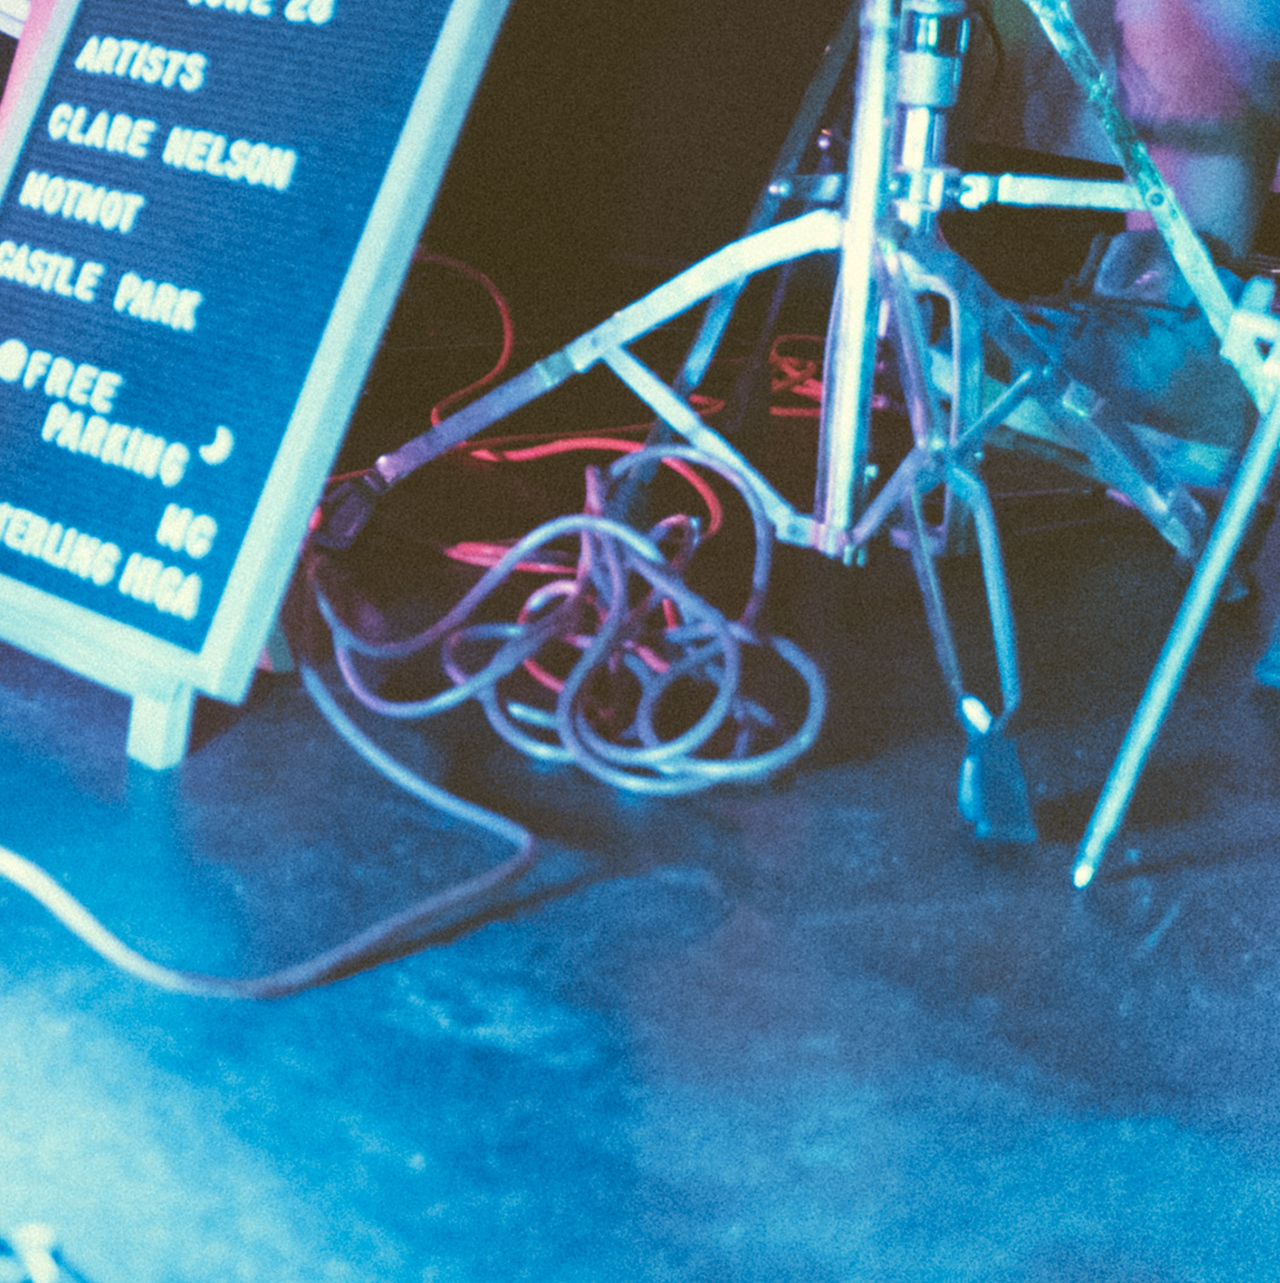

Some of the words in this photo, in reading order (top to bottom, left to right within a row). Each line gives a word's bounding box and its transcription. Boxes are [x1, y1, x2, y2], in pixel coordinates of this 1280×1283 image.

[73, 35, 208, 92] ARTISTS
[47, 102, 158, 160] CLARE
[161, 125, 298, 192] NELSON
[113, 270, 204, 331] PARK
[22, 349, 124, 415] FREE
[40, 400, 191, 488] PARKING
[155, 502, 218, 559] MC
[117, 551, 203, 621] HIGA
